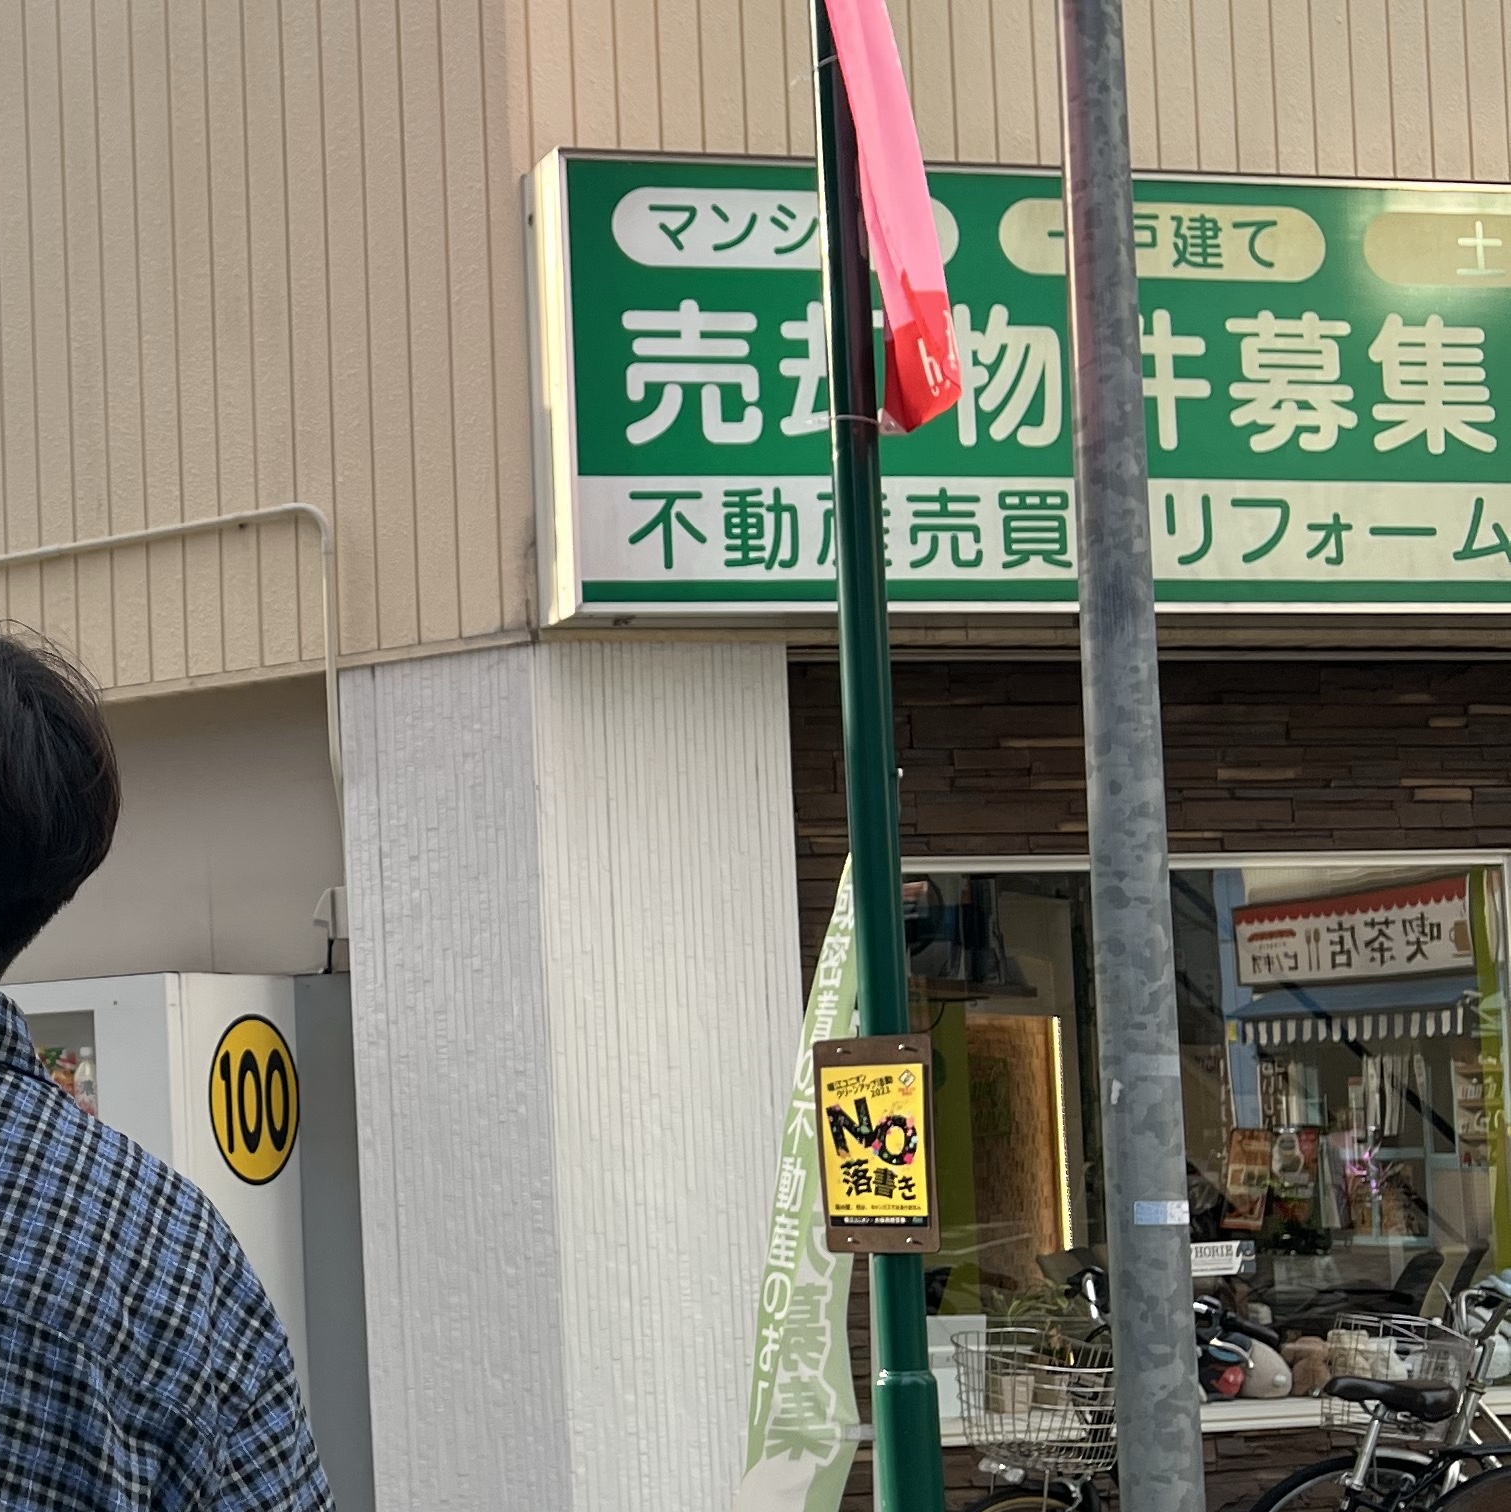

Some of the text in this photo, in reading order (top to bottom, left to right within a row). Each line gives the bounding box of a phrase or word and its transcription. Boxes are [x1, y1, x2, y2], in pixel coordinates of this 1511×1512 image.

[647, 202, 820, 256] マンシ
[628, 486, 1511, 571] 不動売買 リフォーム
[219, 1047, 289, 1155] 100
[840, 1158, 917, 1201] 落書き
